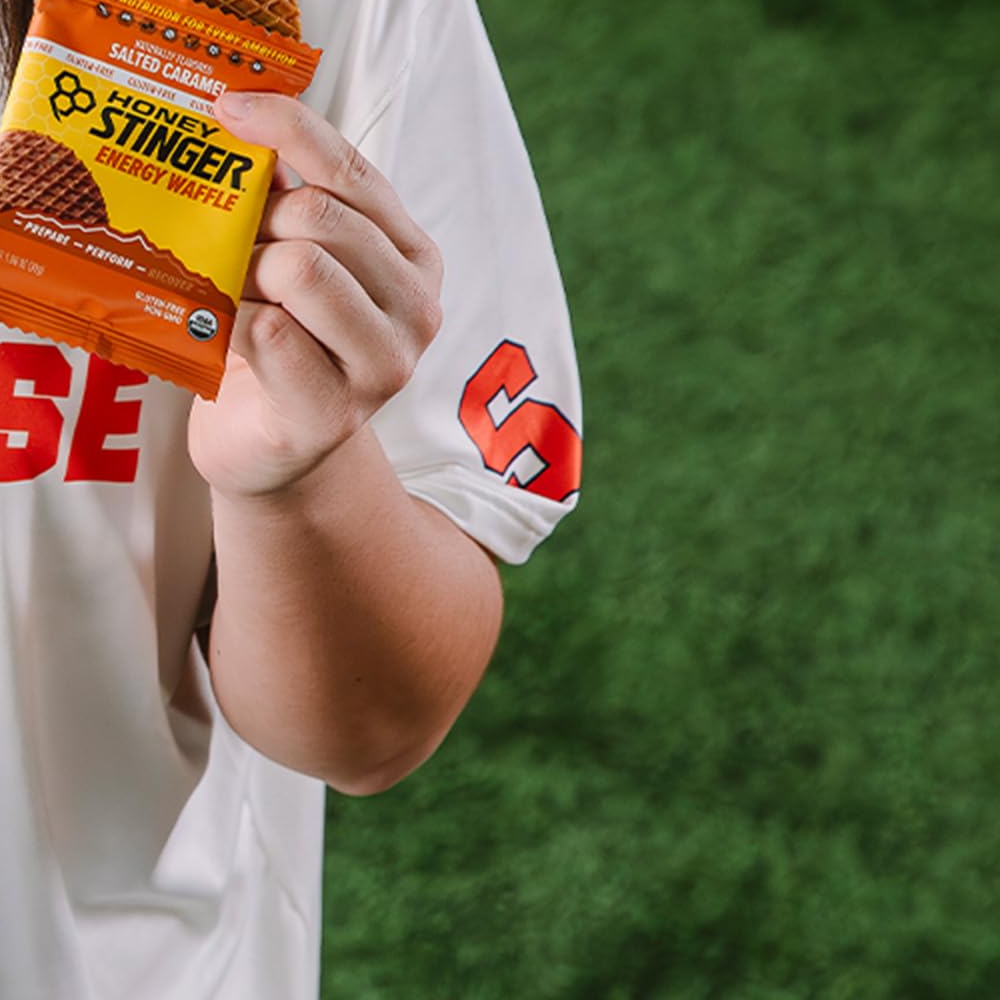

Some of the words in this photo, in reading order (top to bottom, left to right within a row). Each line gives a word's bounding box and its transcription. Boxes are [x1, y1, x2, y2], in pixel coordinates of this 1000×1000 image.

[109, 43, 163, 73] SALTED
[183, 16, 205, 32] FOR
[206, 26, 241, 45] EVERY
[243, 40, 297, 67] AMBITION
[107, 90, 220, 139] HONEY
[89, 106, 254, 189] STINGER
[95, 146, 167, 185] ENERGY
[167, 174, 239, 211] WAFFLE
[24, 222, 71, 245] PREPARE
[84, 245, 134, 270] PERFORM
[458, 338, 582, 502] S
